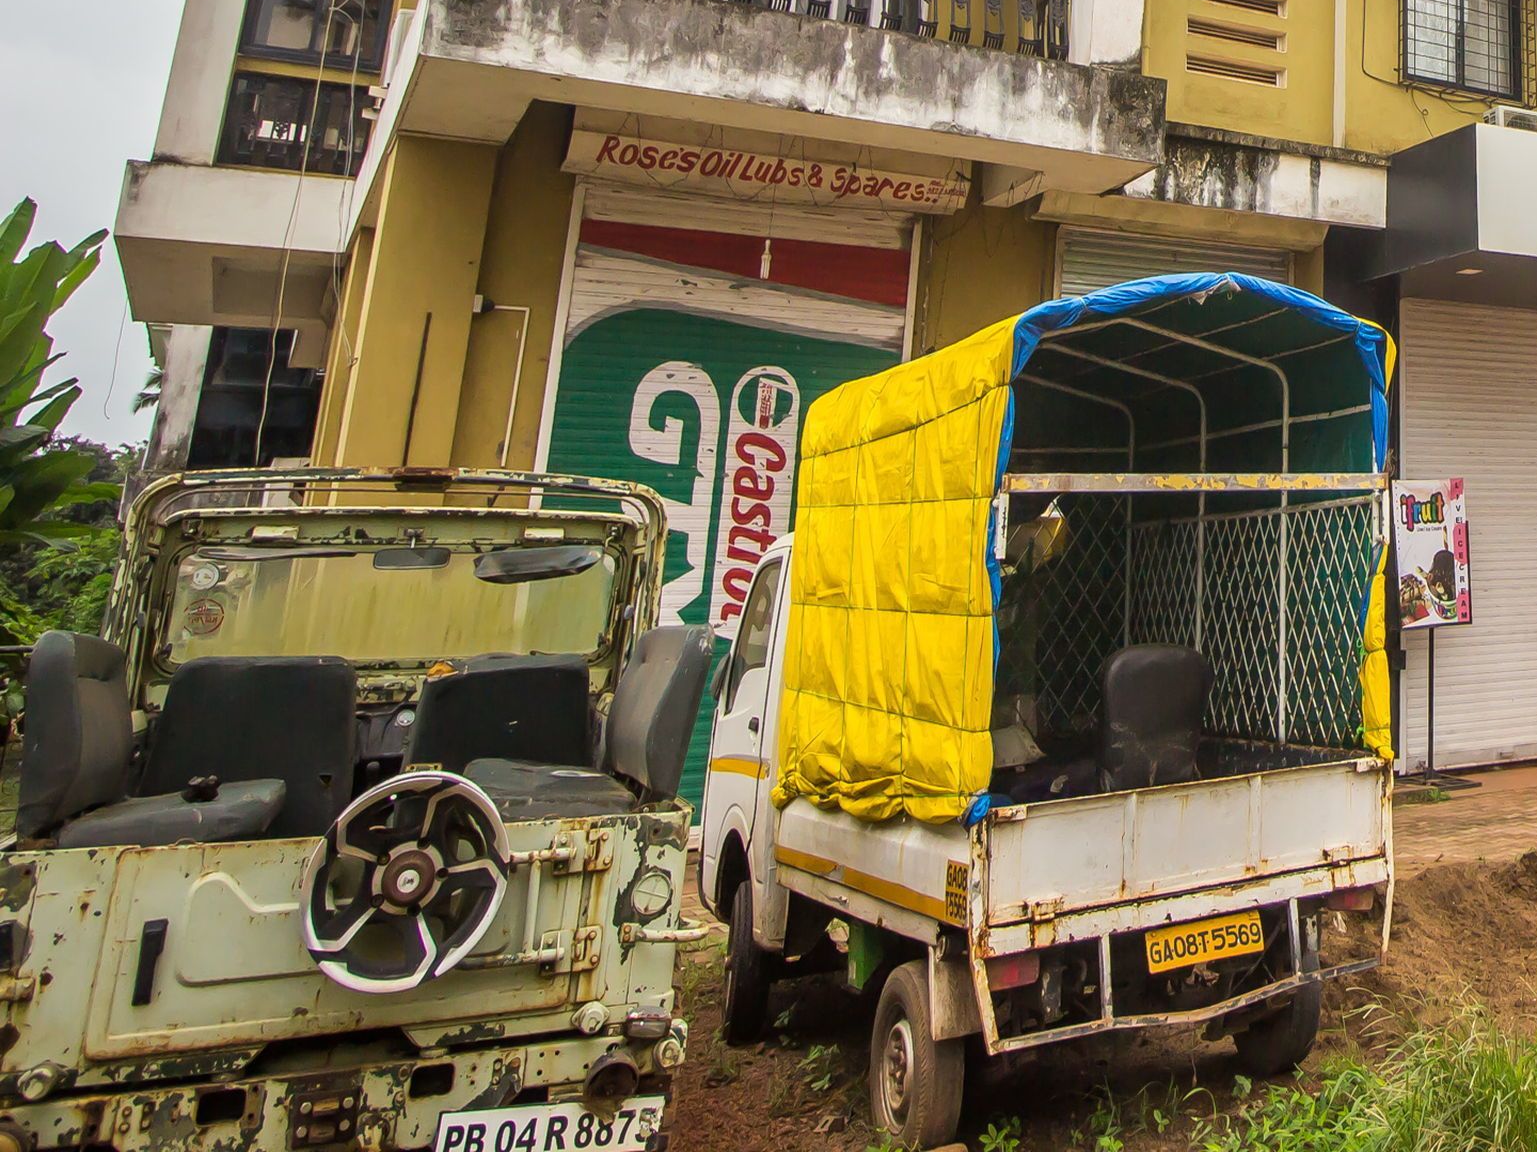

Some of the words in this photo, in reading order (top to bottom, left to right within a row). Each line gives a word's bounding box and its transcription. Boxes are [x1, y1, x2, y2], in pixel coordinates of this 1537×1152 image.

[596, 135, 700, 173] Rose's
[700, 151, 743, 178] Oil
[738, 154, 804, 186] Lubs
[808, 164, 823, 188] &
[1400, 491, 1445, 532] ifruit
[1458, 563, 1468, 619] CREAM
[946, 863, 968, 891] GA08
[443, 1122, 487, 1152] PB
[494, 1117, 538, 1152] 04
[544, 1115, 568, 1152] R
